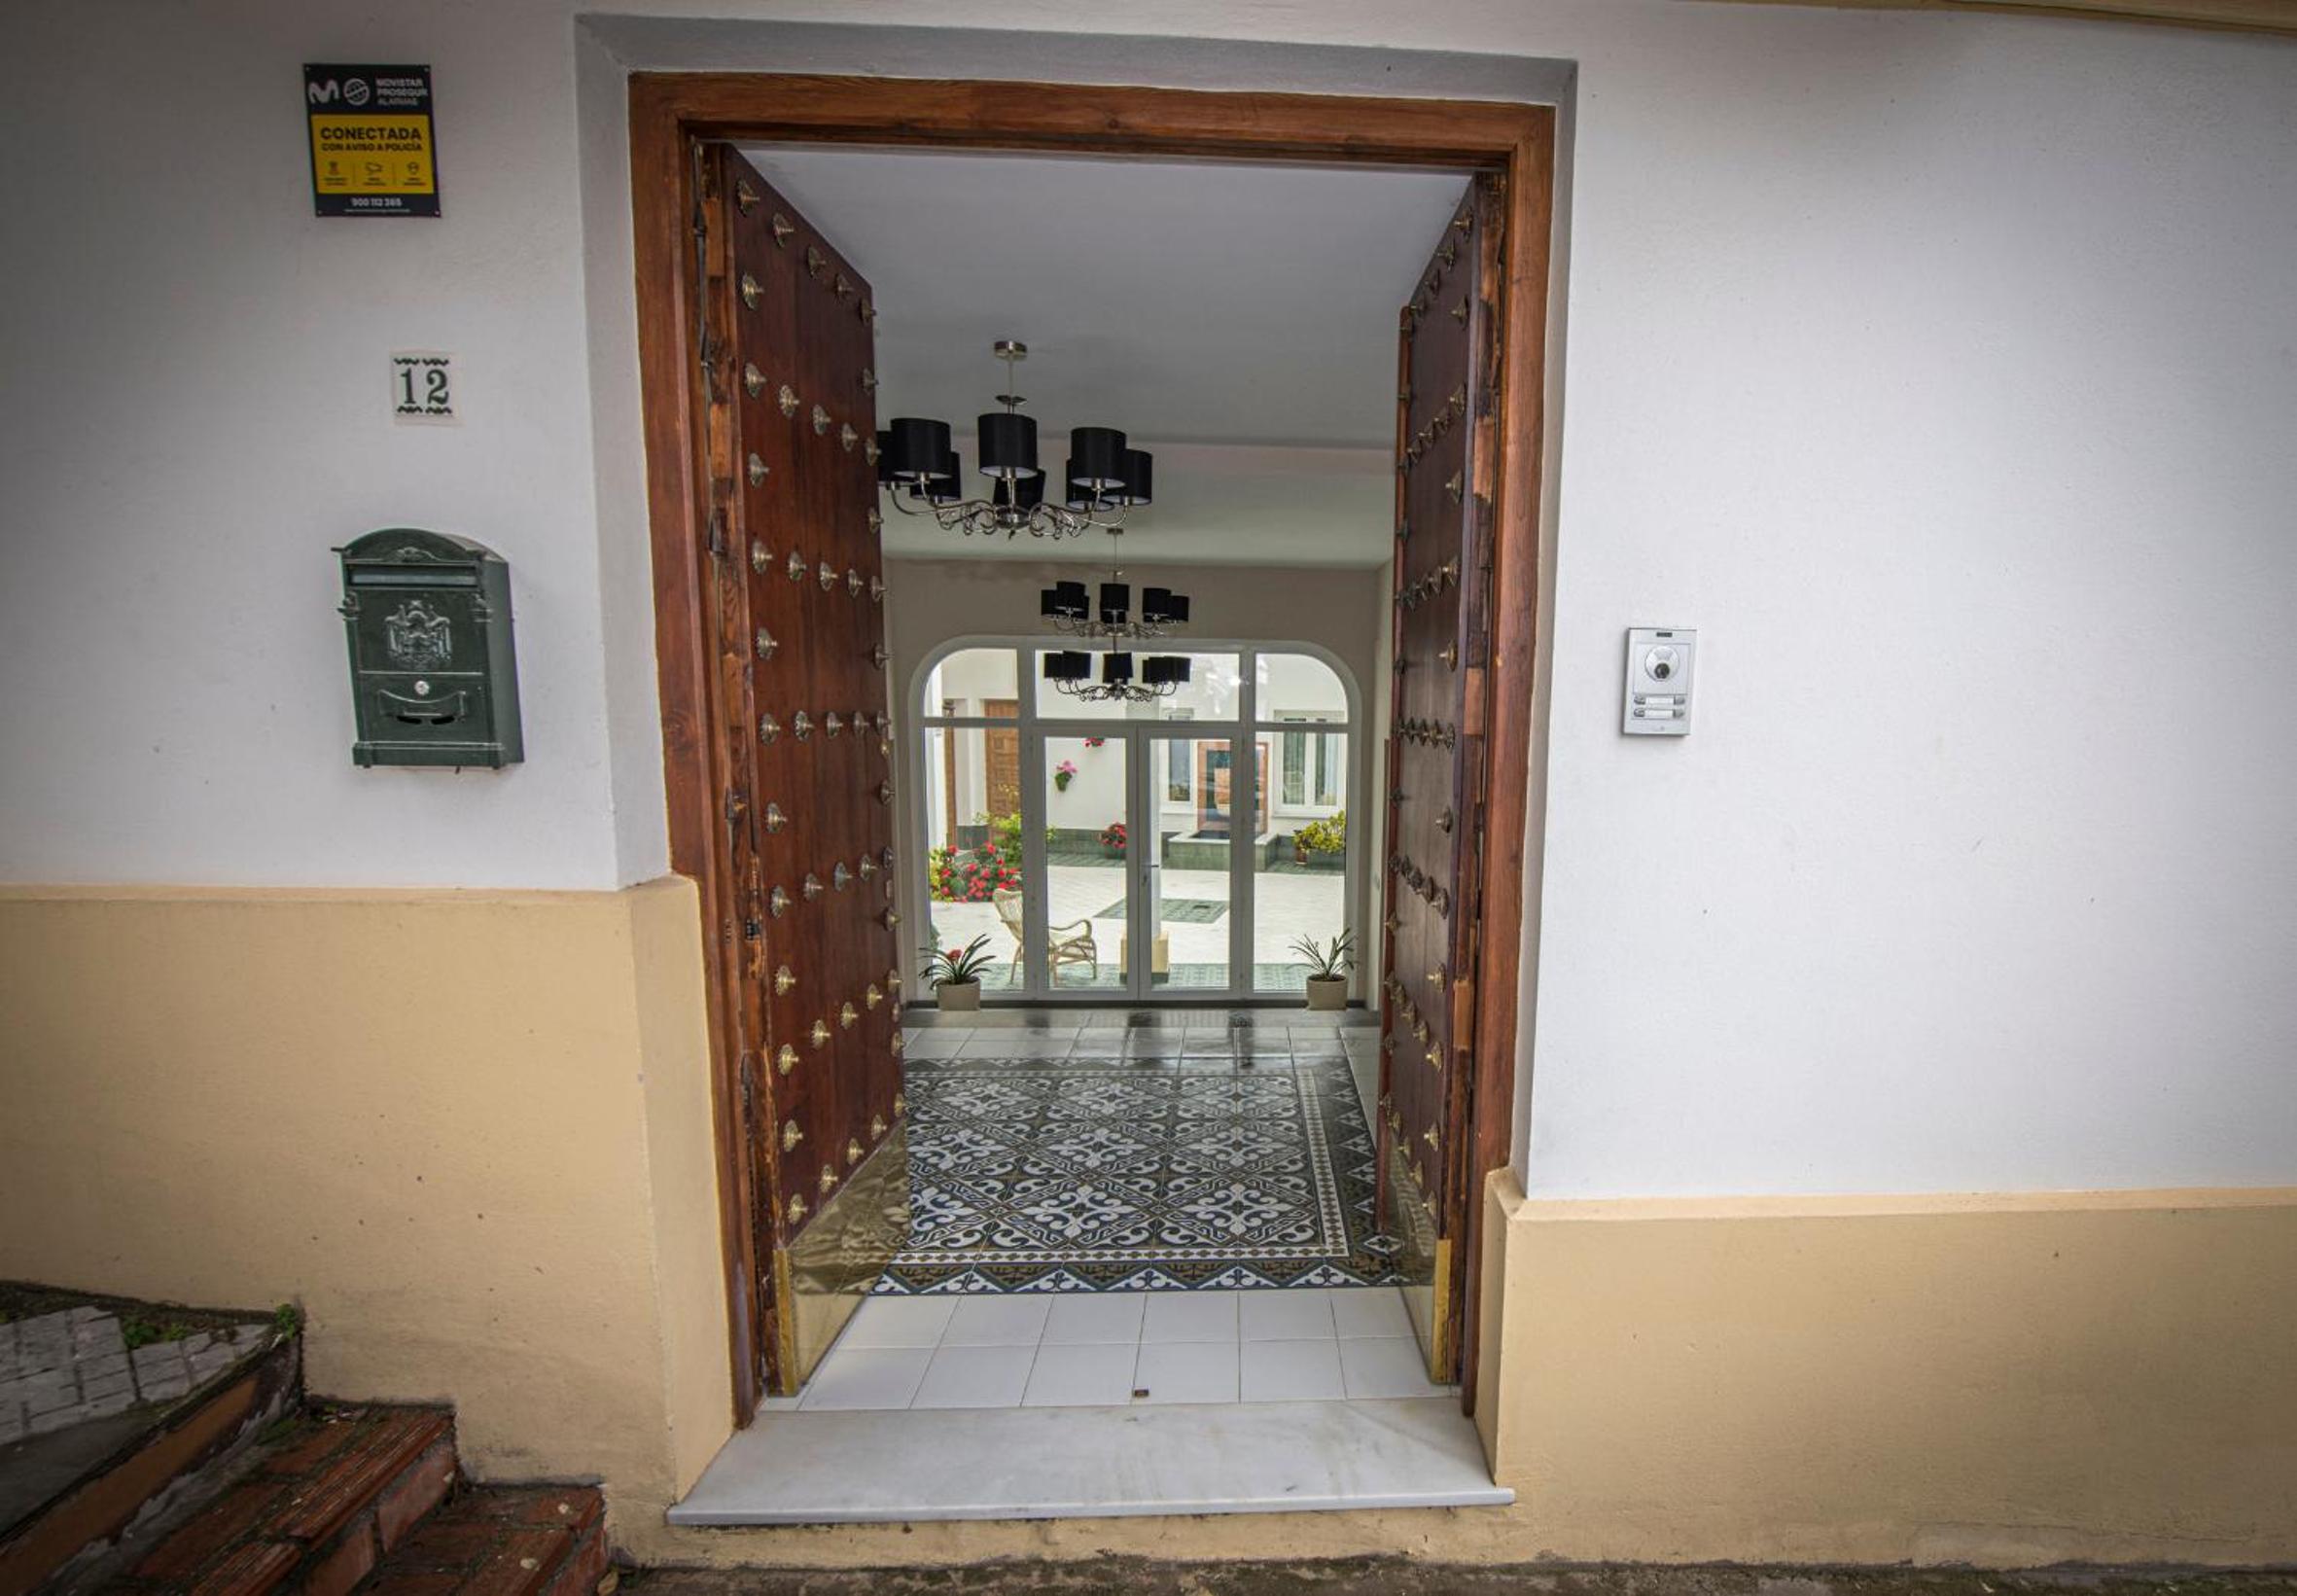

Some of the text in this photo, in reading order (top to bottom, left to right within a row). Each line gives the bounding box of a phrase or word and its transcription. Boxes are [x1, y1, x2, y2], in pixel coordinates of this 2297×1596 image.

[375, 78, 423, 87] MOVISTAR
[321, 127, 421, 140] CONECTADA
[351, 197, 370, 207] 900
[400, 367, 449, 406] 12
